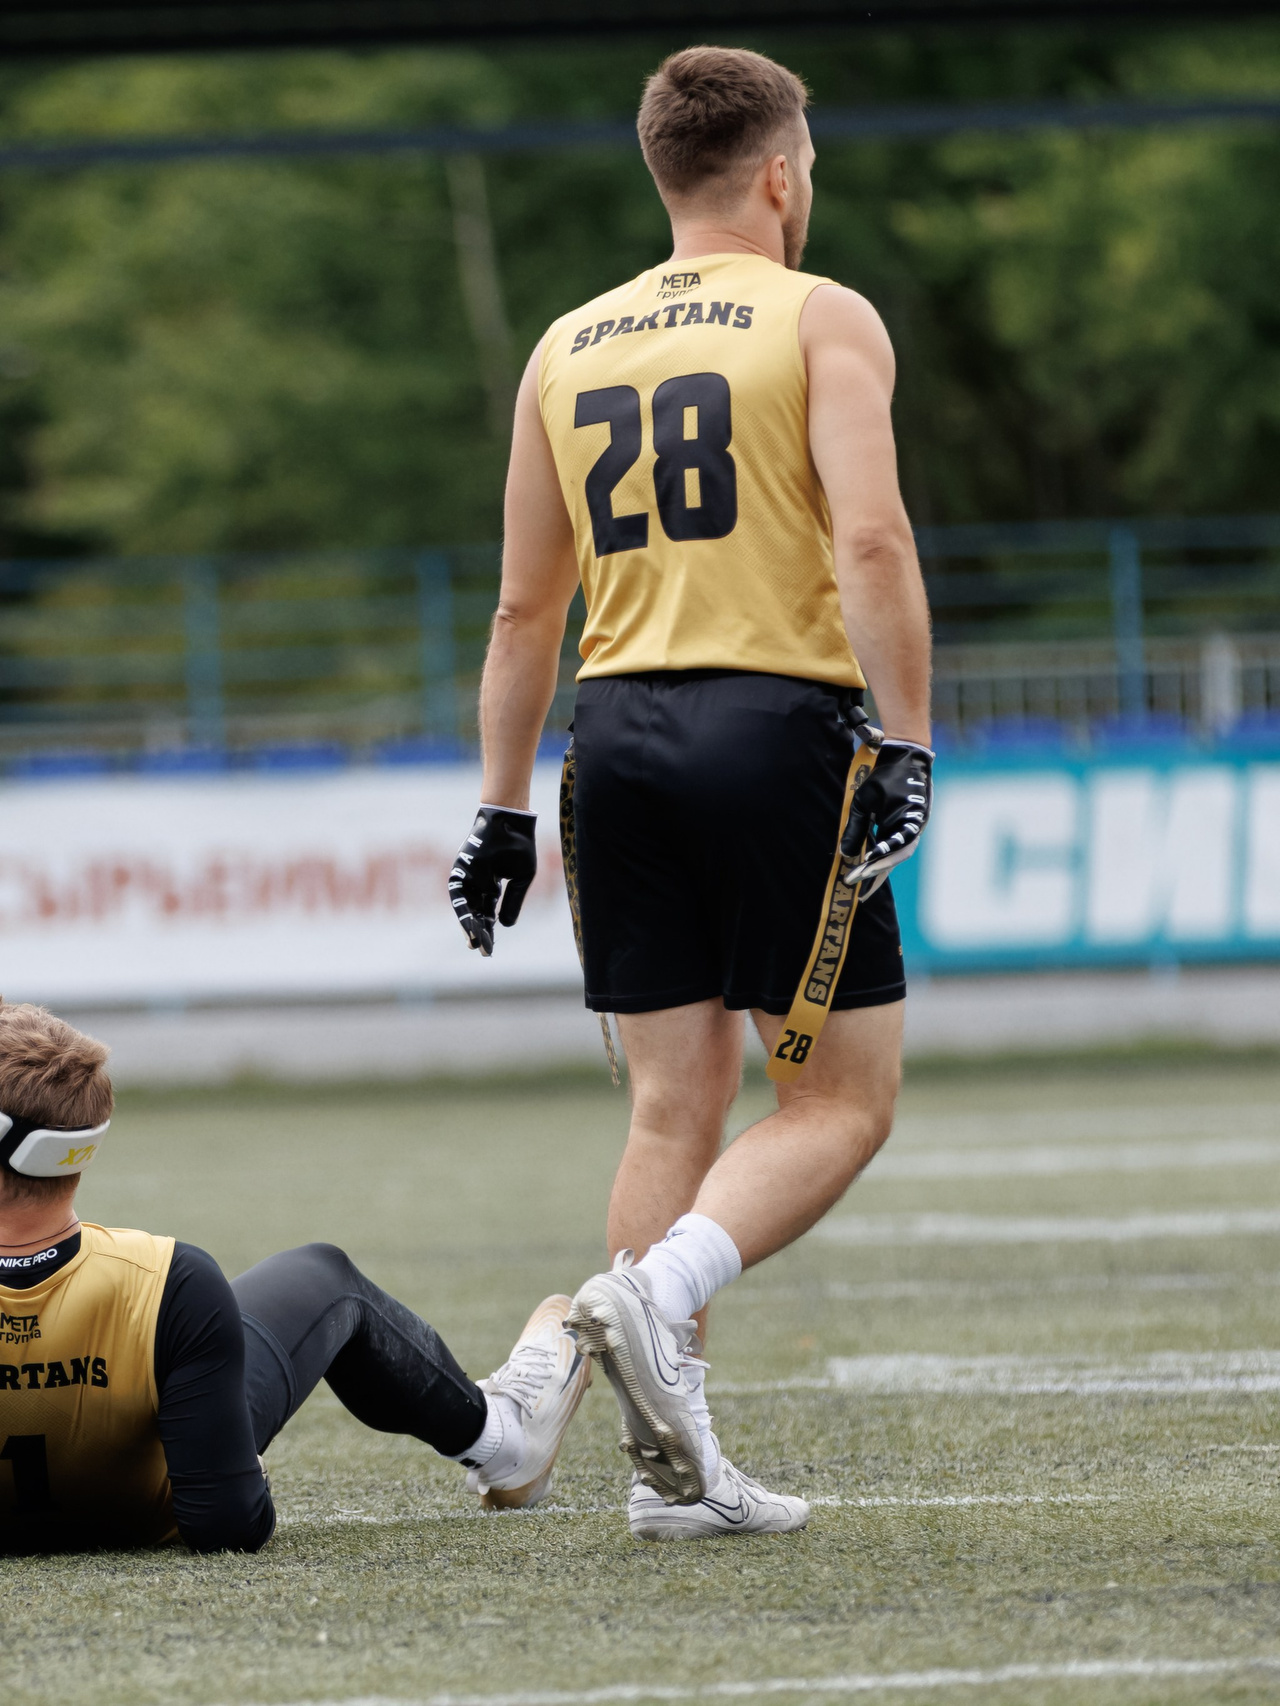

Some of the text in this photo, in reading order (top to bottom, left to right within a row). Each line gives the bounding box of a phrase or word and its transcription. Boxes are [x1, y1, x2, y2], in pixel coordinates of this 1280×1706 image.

[660, 272, 702, 290] МЕТА
[570, 301, 754, 355] SPARTANS
[573, 371, 738, 559] 28
[775, 1029, 813, 1064] 28
[32, 1248, 58, 1266] PRO
[0, 1312, 40, 1333] МЕТА
